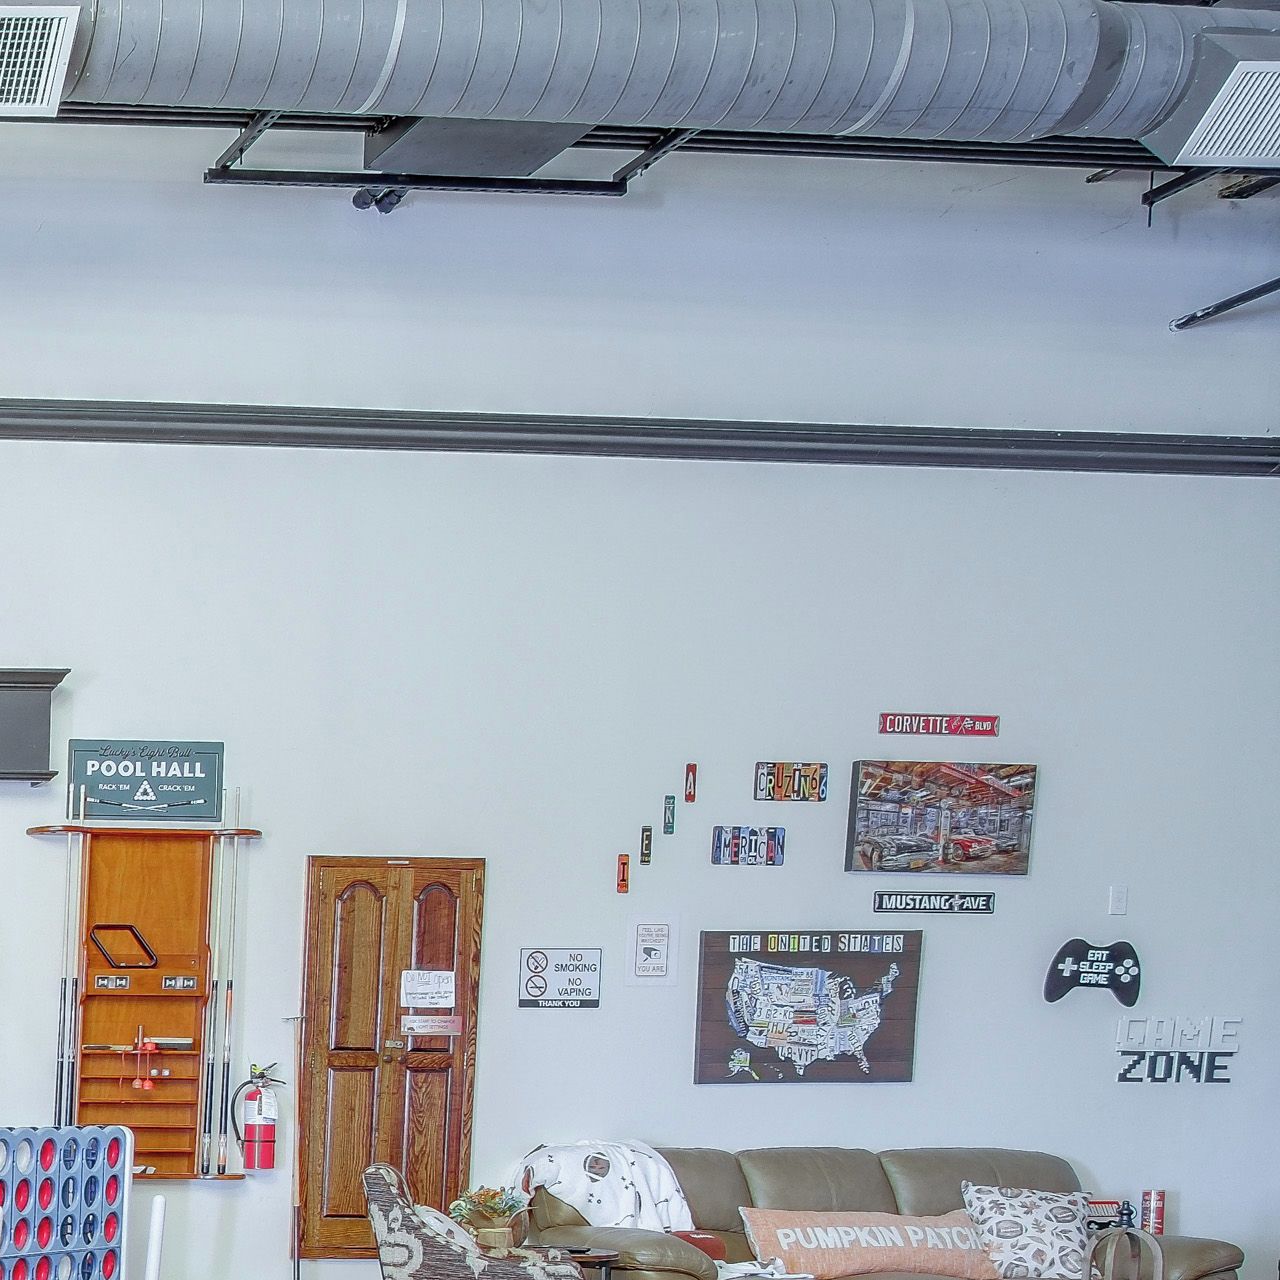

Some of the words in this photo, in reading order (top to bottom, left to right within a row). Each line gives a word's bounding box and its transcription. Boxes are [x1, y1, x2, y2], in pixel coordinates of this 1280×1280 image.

[886, 715, 950, 733] CORVETTE
[975, 721, 992, 731] BLVD
[99, 745, 136, 759] Lucky's
[139, 745, 165, 760] Eight
[167, 746, 192, 758] Ball
[86, 760, 146, 777] POOL
[151, 761, 206, 777] HALL
[686, 772, 694, 795] A
[665, 806, 673, 824] K
[643, 832, 651, 853] E
[714, 831, 784, 862] AMERICAN
[882, 895, 949, 909] MUSTANG
[963, 896, 987, 909] AVE
[731, 936, 759, 951] THE
[769, 936, 830, 951] UNITED
[839, 935, 903, 951] STATES
[569, 953, 583, 962] NO
[1088, 950, 1109, 961] EAT
[554, 964, 597, 972] SMOKING
[1079, 961, 1114, 973] SLEEP
[568, 978, 582, 986] NO
[1080, 973, 1110, 984] GAME
[558, 988, 592, 997] VAPING
[1116, 1016, 1243, 1052] GAME
[1117, 1051, 1235, 1083] ZONE
[776, 1226, 904, 1250] PUMPKIN
[904, 1226, 983, 1250] PATCH
